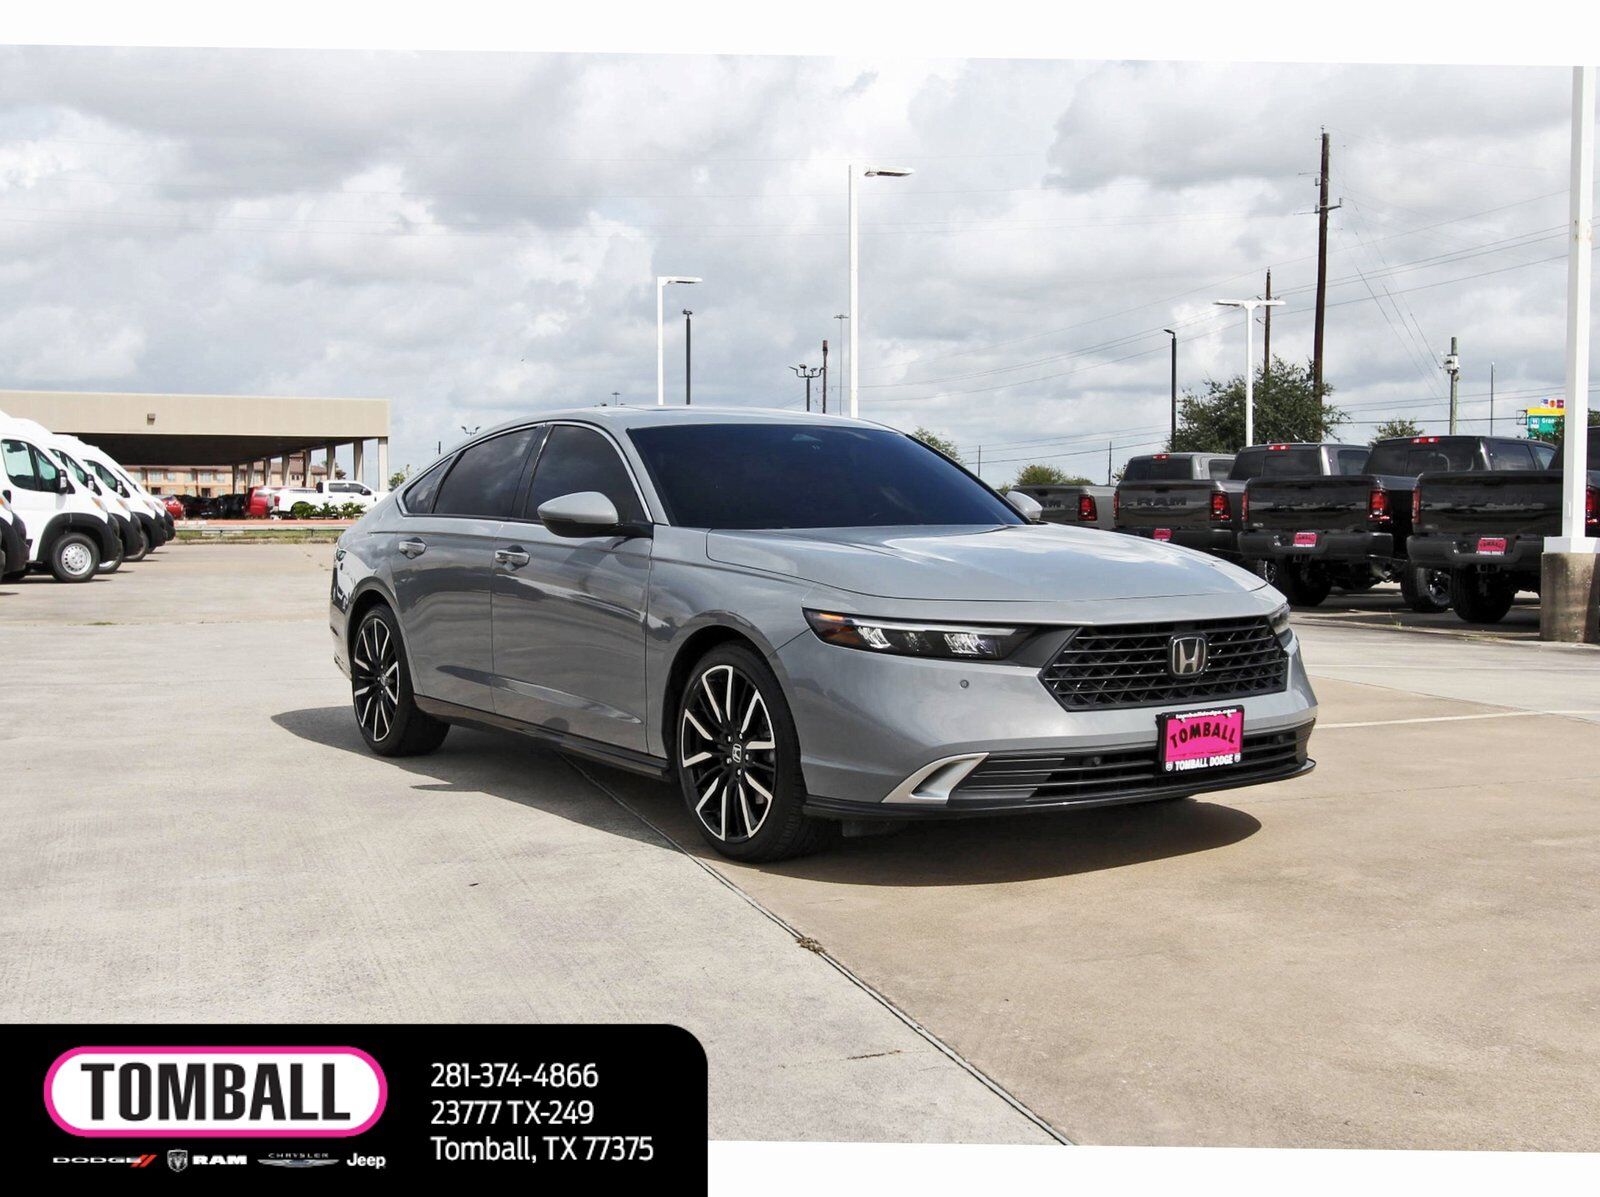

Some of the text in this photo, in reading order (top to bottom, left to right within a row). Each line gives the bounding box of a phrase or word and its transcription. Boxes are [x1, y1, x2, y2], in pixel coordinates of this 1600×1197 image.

[1136, 497, 1187, 506] RAM
[1170, 722, 1236, 749] TOMBALL
[1175, 754, 1233, 771] TOMBALL DODGE
